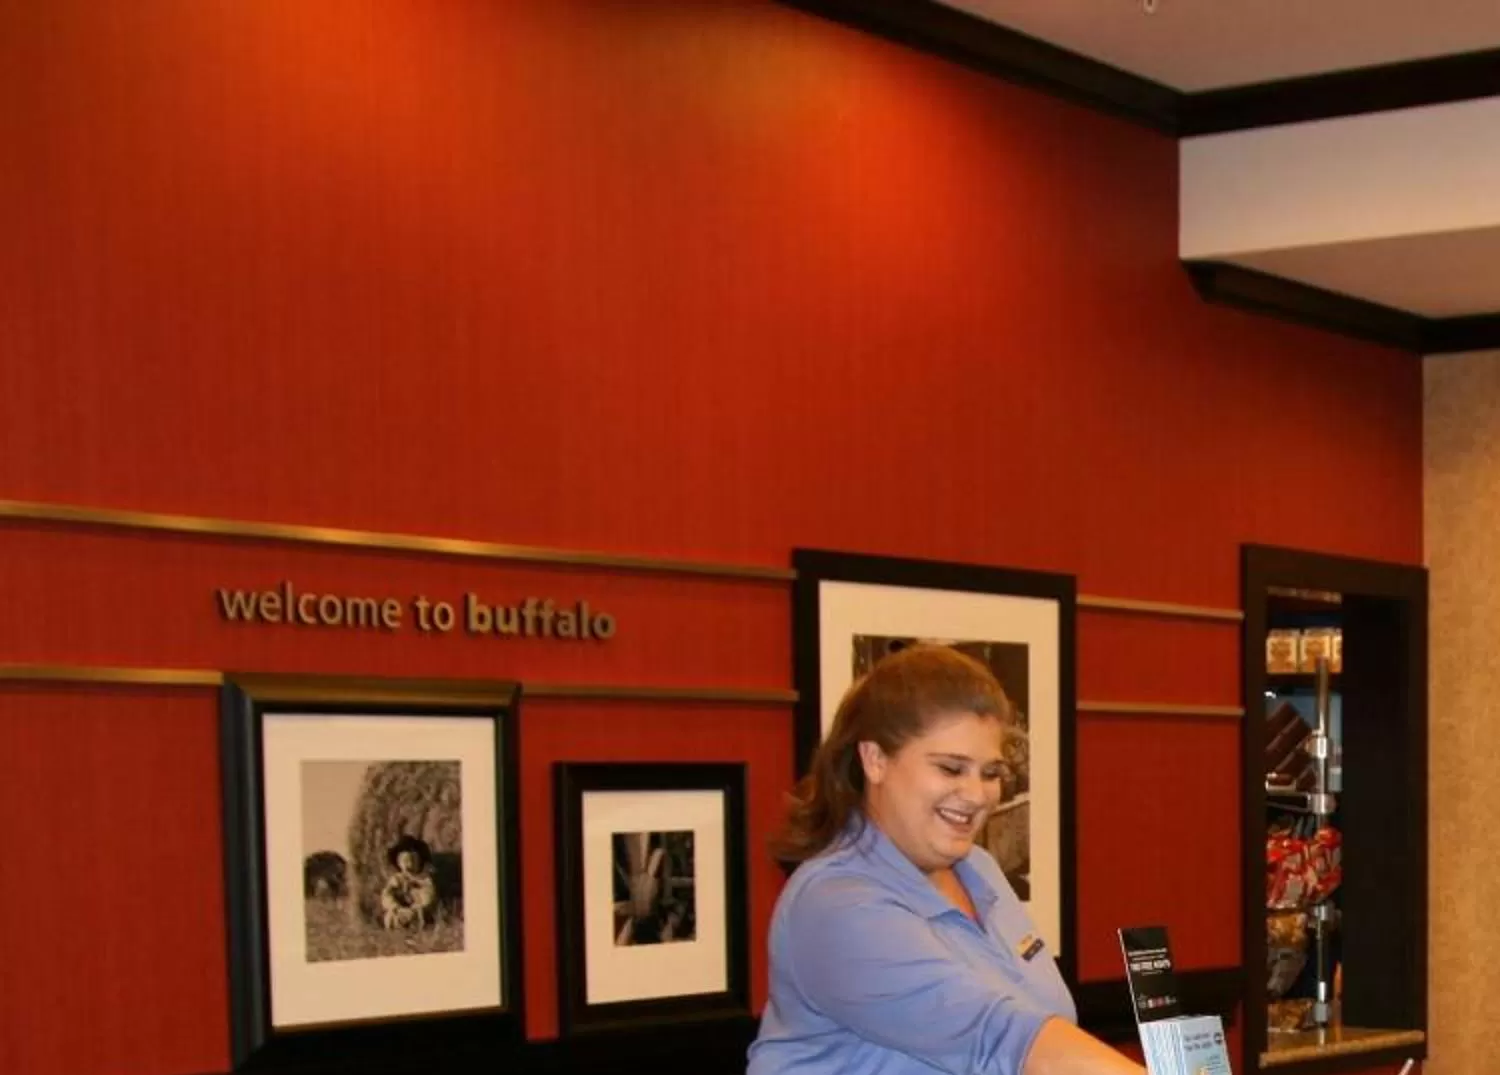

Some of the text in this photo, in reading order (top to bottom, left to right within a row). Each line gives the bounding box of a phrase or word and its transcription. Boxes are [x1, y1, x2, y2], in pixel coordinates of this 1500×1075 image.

[219, 581, 617, 639] welcome to buffalo
